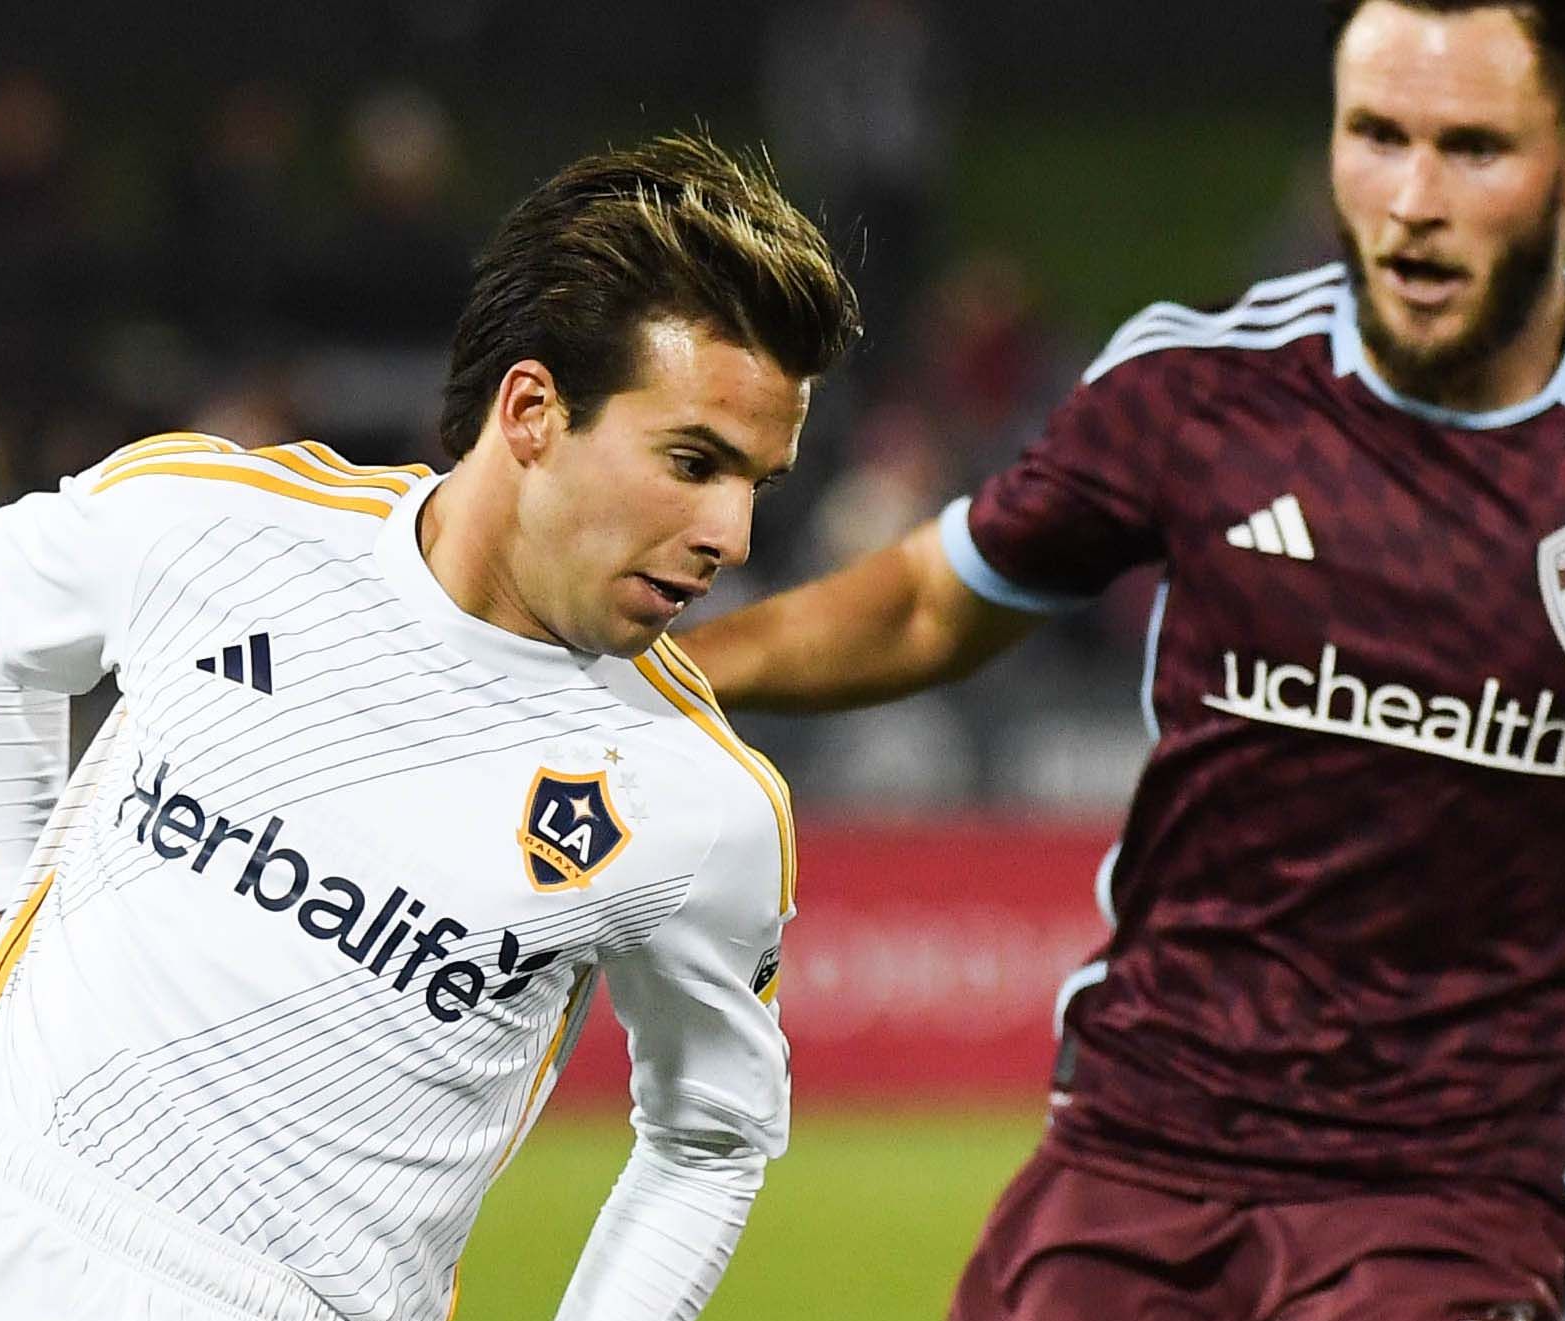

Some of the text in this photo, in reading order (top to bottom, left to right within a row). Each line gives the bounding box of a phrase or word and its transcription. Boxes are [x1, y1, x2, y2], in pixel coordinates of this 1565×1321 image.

[524, 836, 582, 879] GALAXY
[537, 799, 592, 864] LA
[115, 750, 485, 1023] Herbalife
